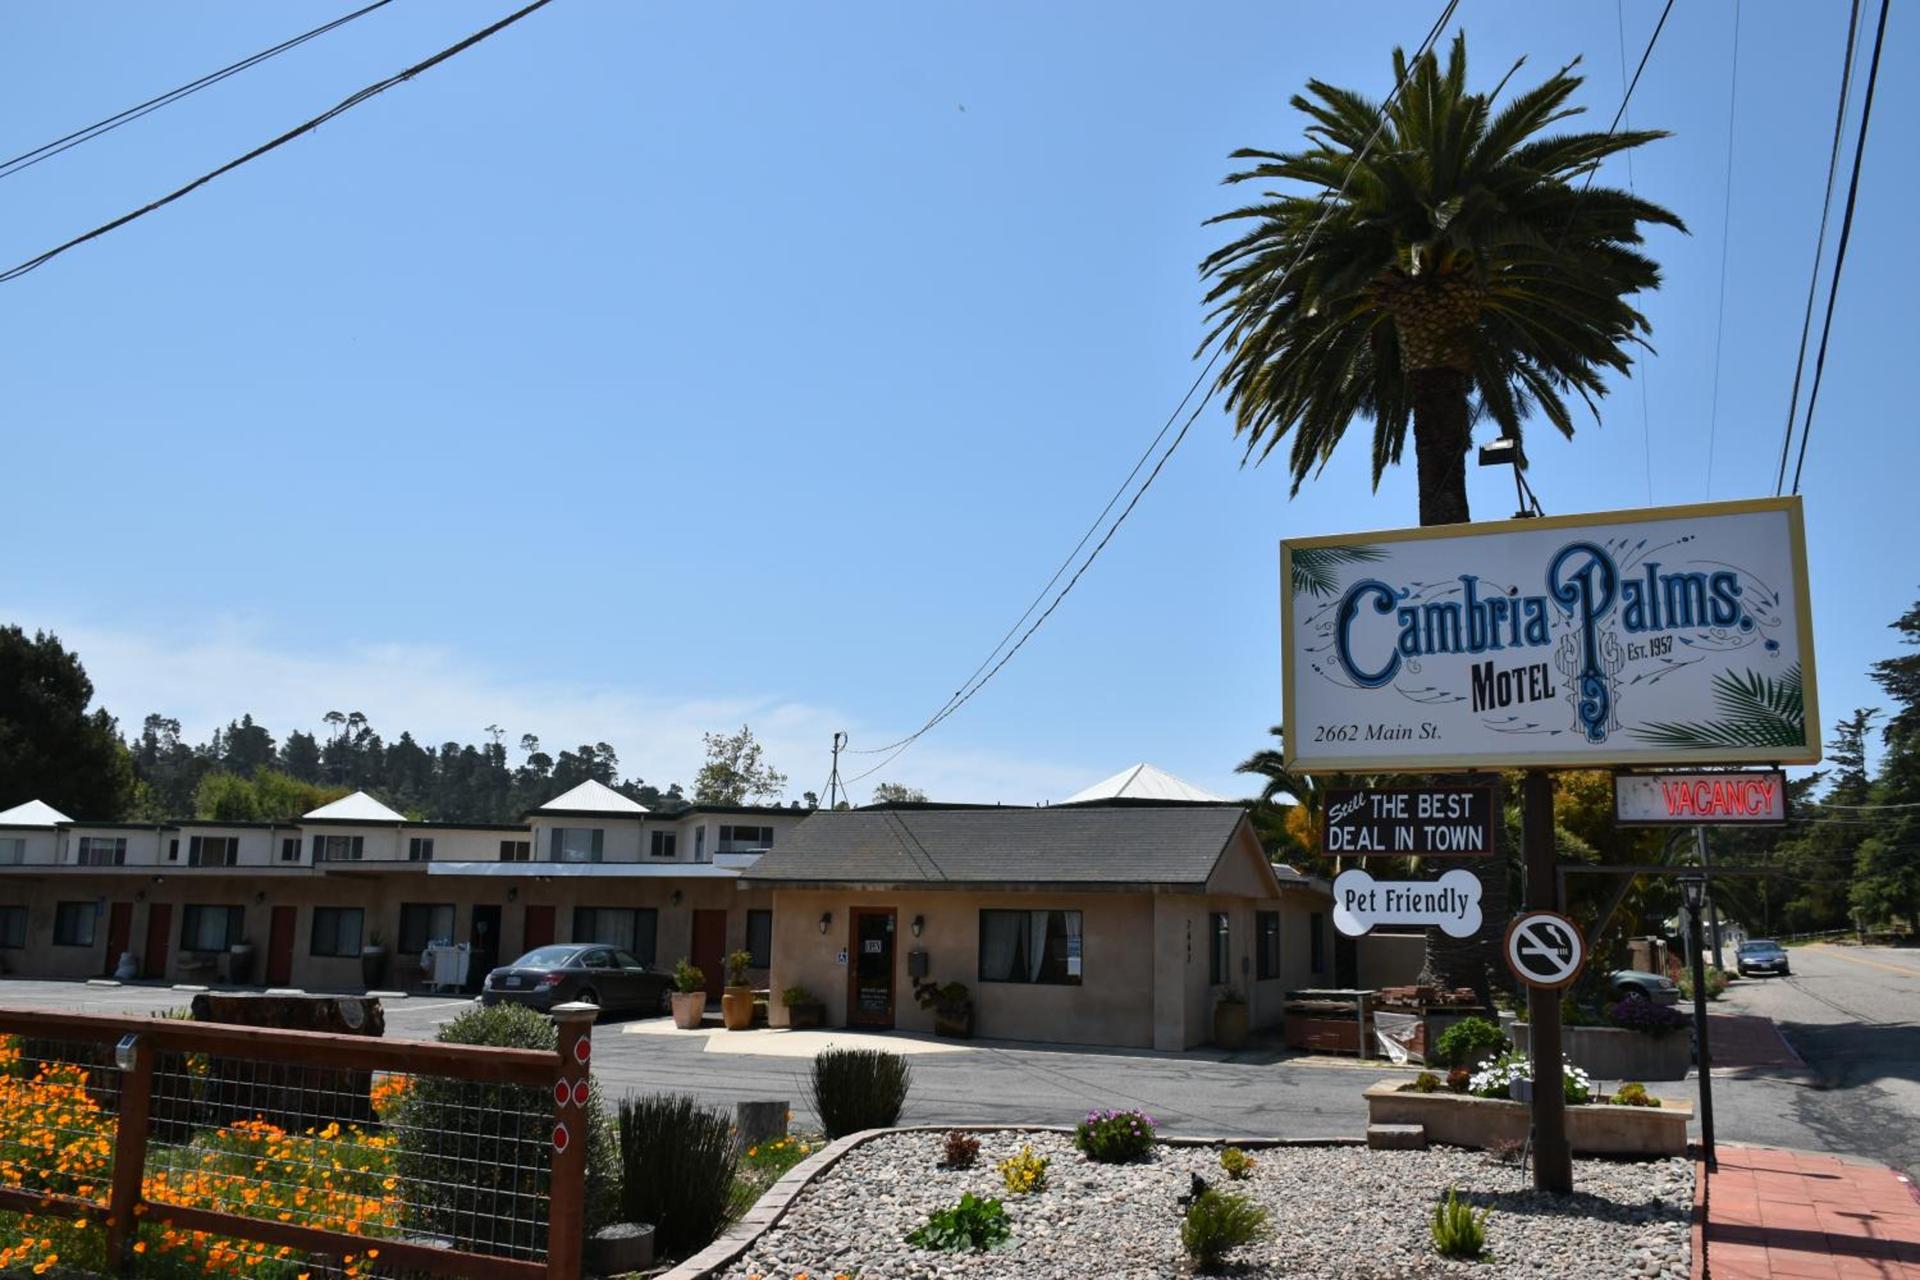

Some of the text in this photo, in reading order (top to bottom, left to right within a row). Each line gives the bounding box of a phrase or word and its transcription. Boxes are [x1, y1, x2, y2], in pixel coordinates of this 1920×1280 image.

[1335, 574, 1552, 689] Cambria
[1650, 635, 1673, 657] 1957
[1471, 661, 1555, 712] MOTEL
[1314, 722, 1442, 742] 2662 Main St.
[1328, 791, 1474, 825] Still THE BEST
[1662, 779, 1776, 816] VACANCY
[1328, 825, 1483, 851] DEAL IN TOWN
[1345, 887, 1469, 919] Pet Friendly
